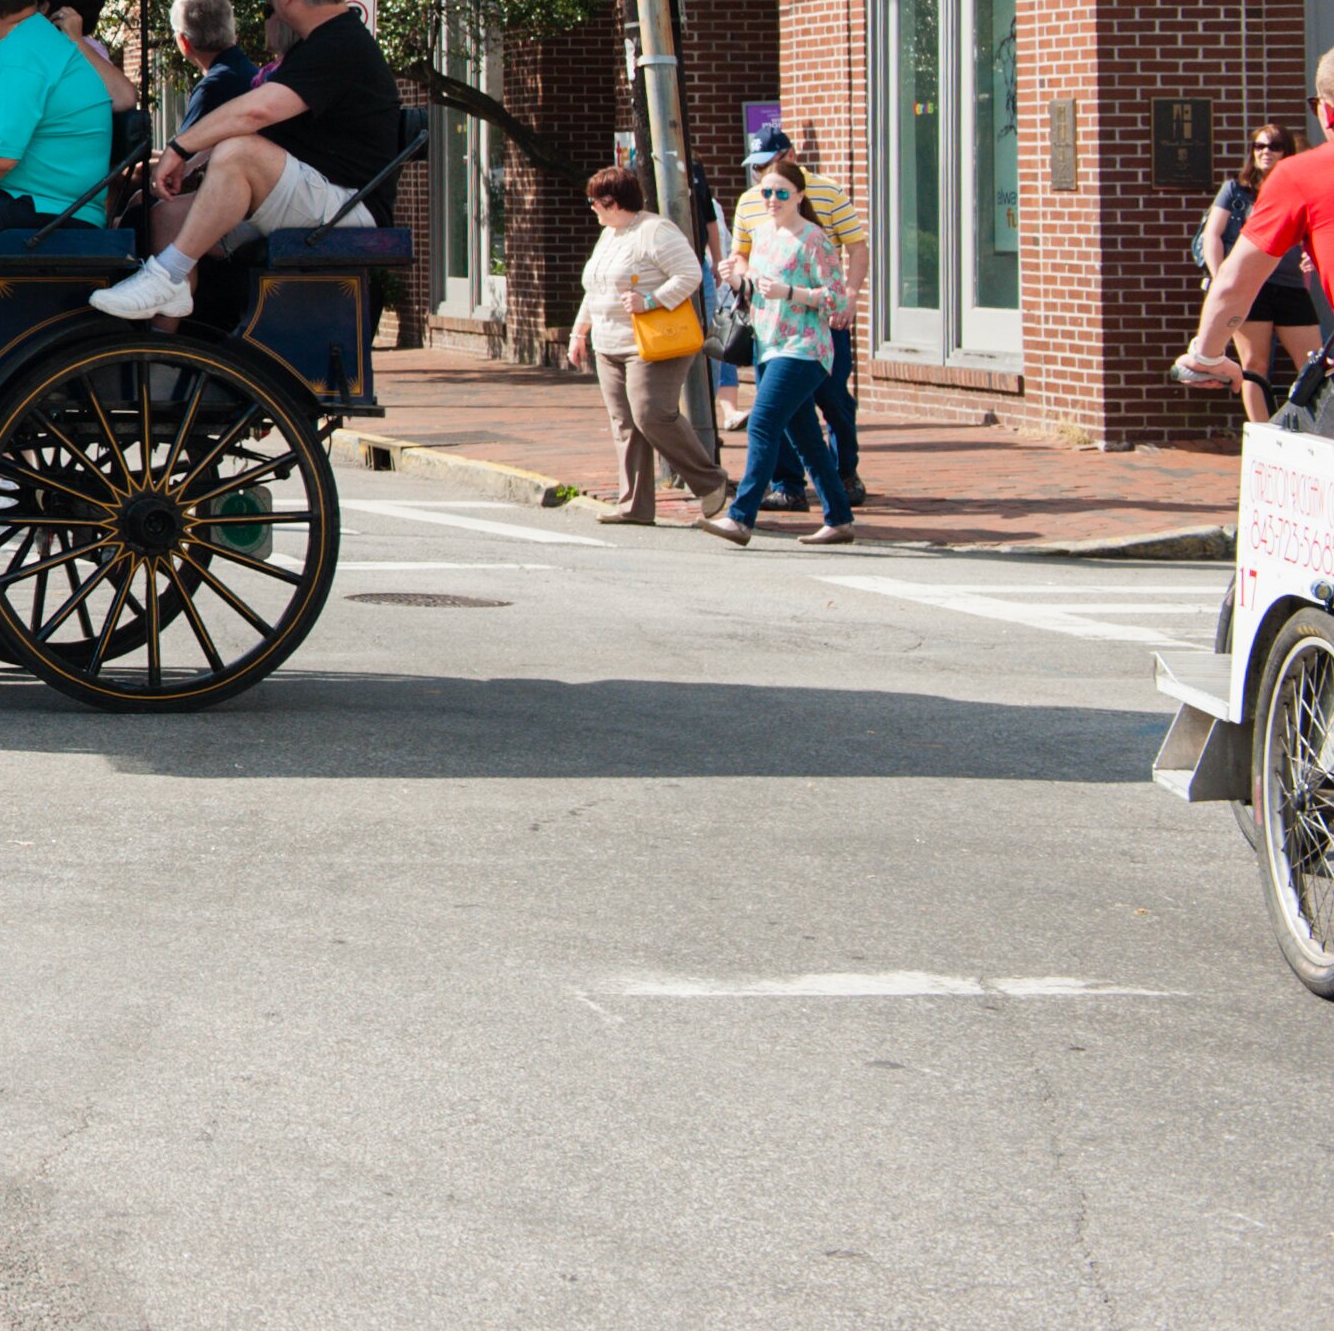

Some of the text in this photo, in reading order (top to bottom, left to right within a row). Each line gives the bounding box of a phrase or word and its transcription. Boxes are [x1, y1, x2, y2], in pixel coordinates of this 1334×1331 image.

[997, 187, 1017, 206] alwa
[1250, 508, 1334, 576] 843-723-568
[1239, 567, 1258, 611] 17
